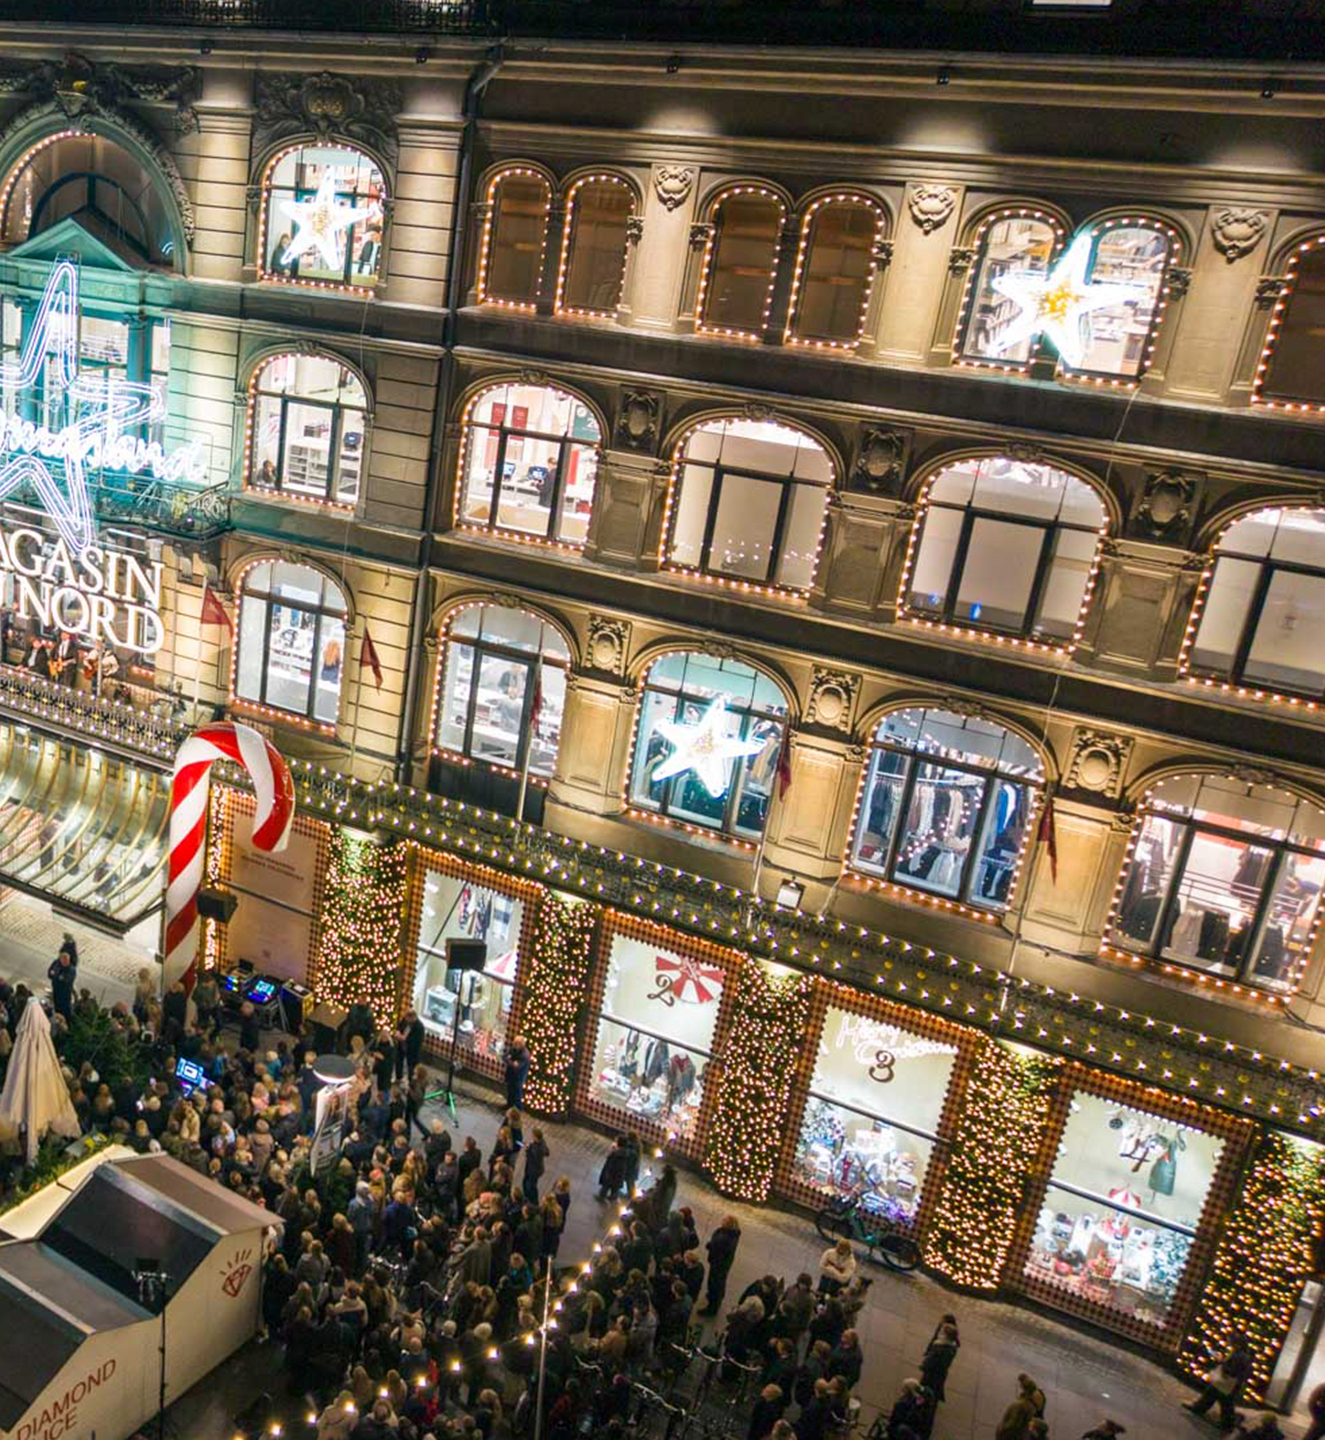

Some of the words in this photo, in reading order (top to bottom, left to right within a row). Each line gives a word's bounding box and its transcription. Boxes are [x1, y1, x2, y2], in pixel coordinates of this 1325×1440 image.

[16, 573, 165, 654] NORD
[647, 974, 675, 1007] 2
[868, 1050, 896, 1083] 3
[17, 1359, 116, 1440] DIAMOND
